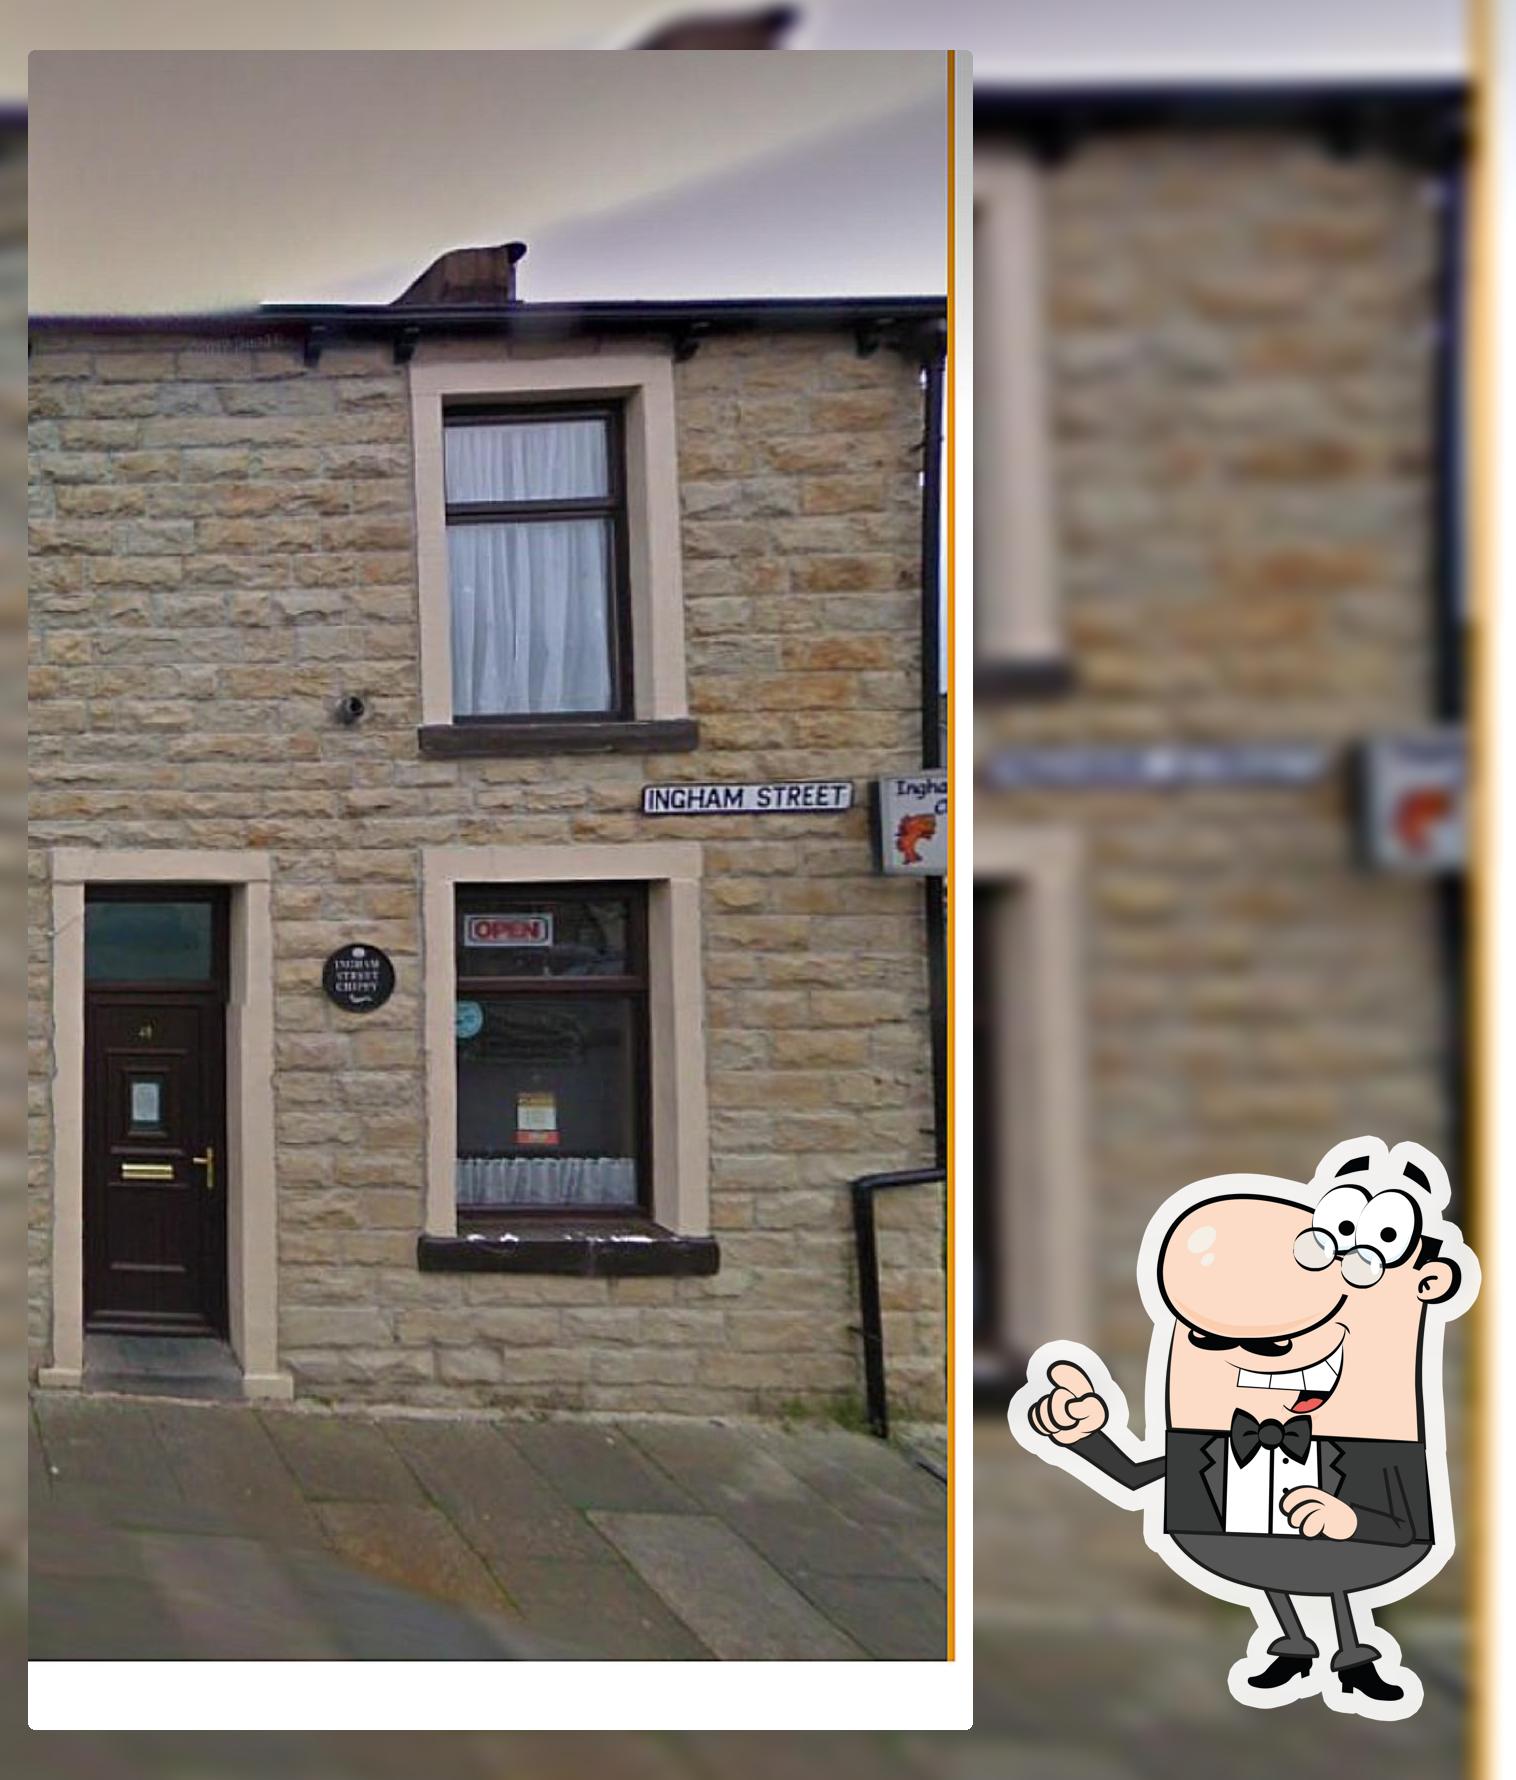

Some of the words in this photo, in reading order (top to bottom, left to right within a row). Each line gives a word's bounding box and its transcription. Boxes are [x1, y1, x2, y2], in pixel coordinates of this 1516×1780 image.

[649, 788, 744, 810] INGHAM
[757, 785, 847, 807] STREET
[475, 920, 540, 939] OPEN
